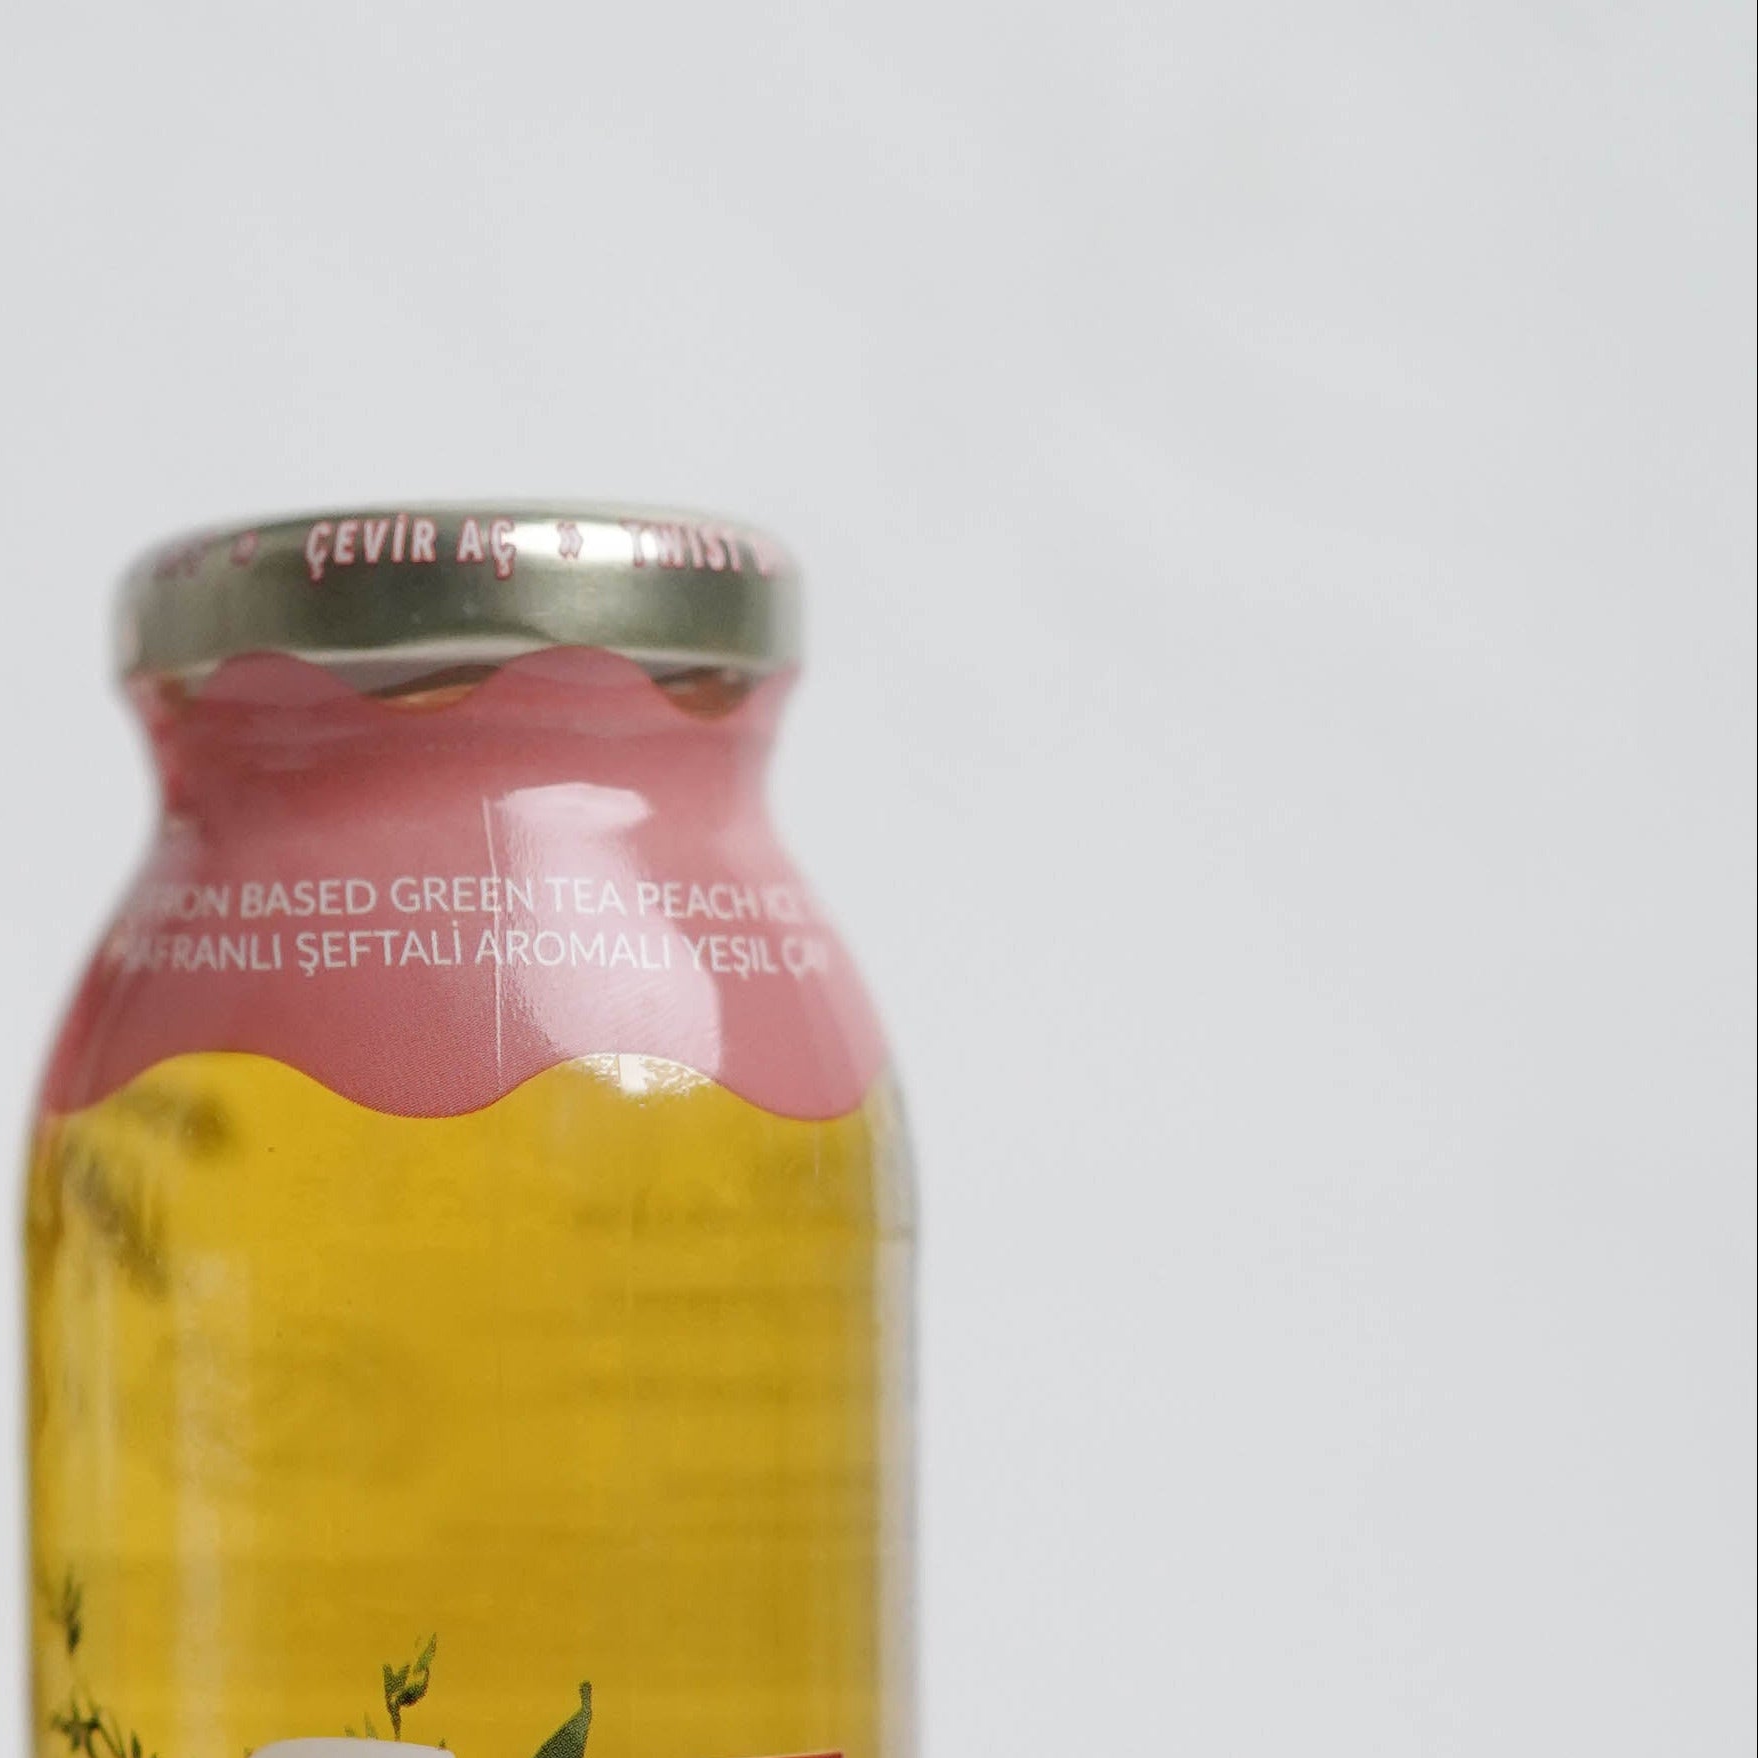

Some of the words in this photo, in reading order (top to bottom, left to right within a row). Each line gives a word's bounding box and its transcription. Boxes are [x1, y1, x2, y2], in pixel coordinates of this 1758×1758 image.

[305, 513, 437, 583] ÇEVİR
[455, 517, 516, 579] AÇ
[619, 516, 743, 573] TWIST
[240, 874, 377, 919] BASED
[390, 875, 534, 915] GREEN
[545, 876, 627, 916] TEA
[636, 879, 760, 921] PEACH
[295, 921, 463, 977] ŞEFTALİ
[473, 928, 672, 970] AROMALI
